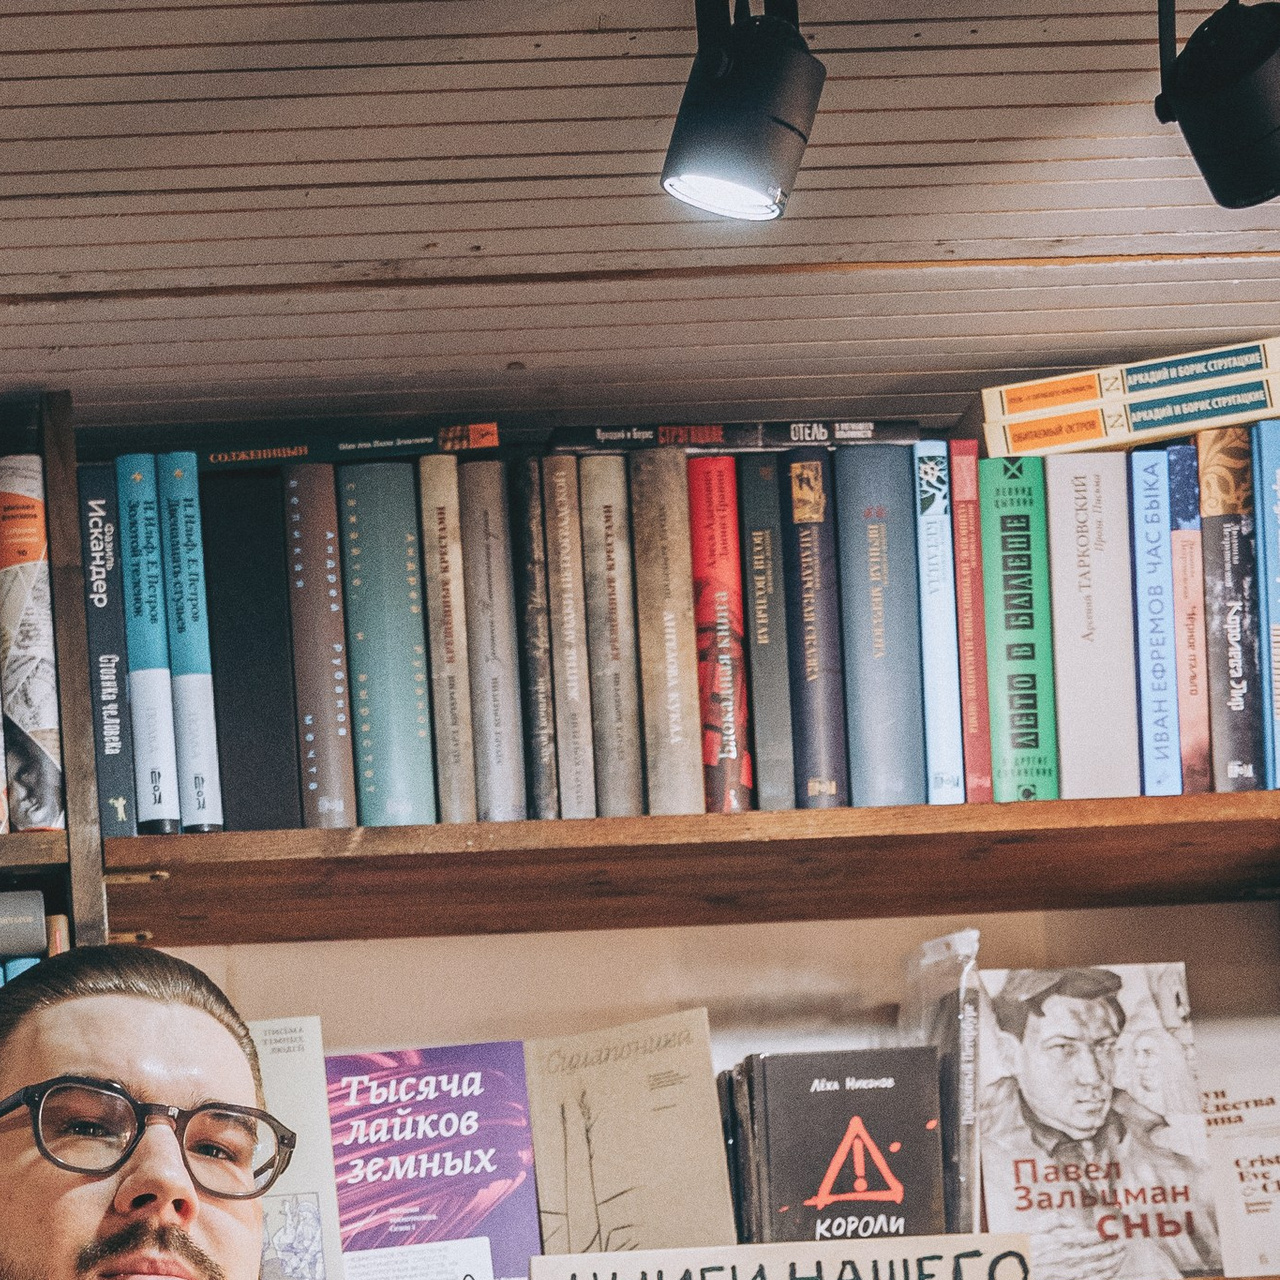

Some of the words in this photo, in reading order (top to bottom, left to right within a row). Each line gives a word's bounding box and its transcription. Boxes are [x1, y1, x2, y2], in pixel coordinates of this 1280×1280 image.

[1143, 464, 1159, 527] БЫКА
[88, 499, 108, 608] Искандер
[1146, 531, 1162, 574] ЧАС
[1147, 585, 1168, 690] ЕФРЕМОВ
[1152, 696, 1169, 760] ИВАН
[338, 1071, 485, 1107] Тысяча
[342, 1108, 480, 1147] лайков
[346, 1147, 498, 1186] земных
[1013, 1159, 1122, 1184] Павел
[1014, 1184, 1191, 1212] Зальцман
[815, 1213, 905, 1242] КОРОЛИ
